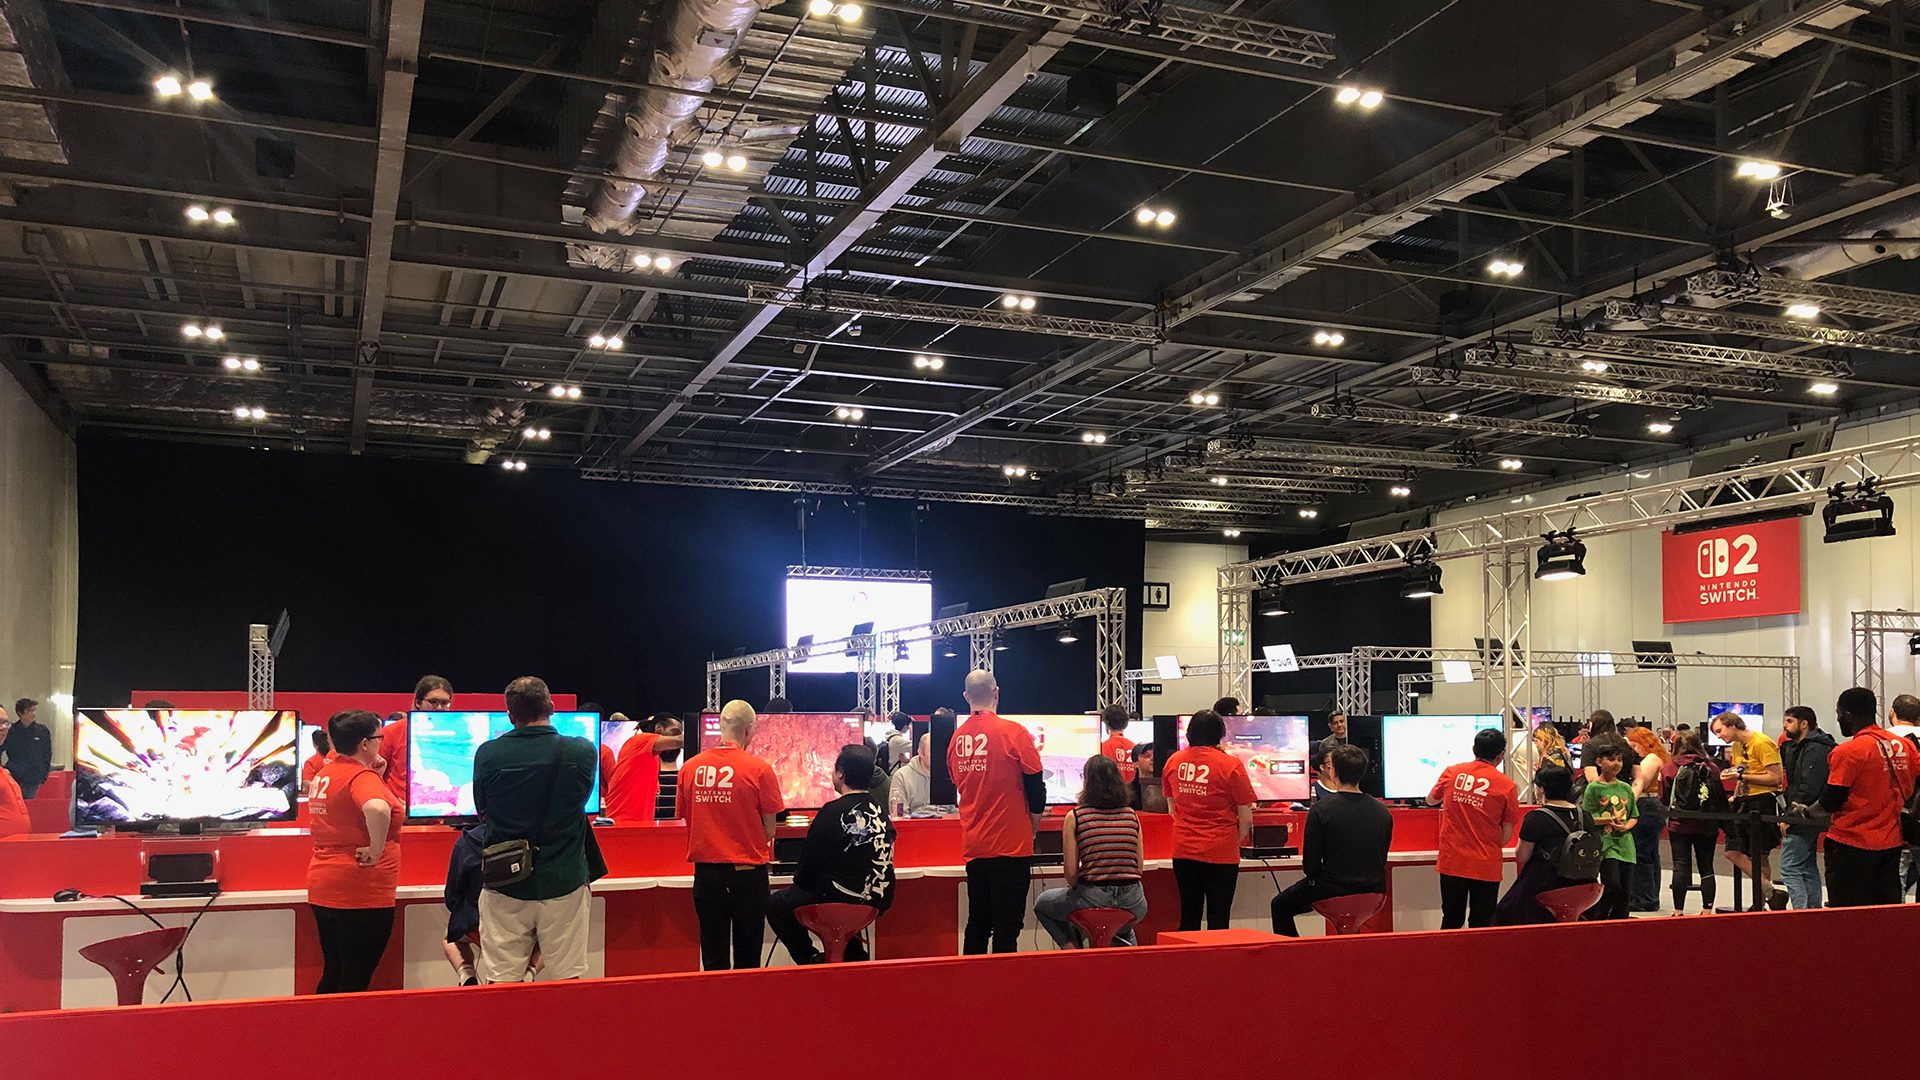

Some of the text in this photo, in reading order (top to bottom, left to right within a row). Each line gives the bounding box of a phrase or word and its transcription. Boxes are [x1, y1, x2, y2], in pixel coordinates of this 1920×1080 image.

[1732, 534, 1758, 575] 2
[1700, 579, 1757, 591] NINTENDO
[1700, 588, 1757, 605] SWITCH
[1271, 657, 1293, 667] TOUR
[973, 733, 988, 756] 2
[1890, 739, 1907, 757] 2
[718, 765, 735, 788] 2
[958, 763, 987, 773] SWITCH
[1195, 764, 1210, 784] 2
[316, 775, 330, 800] 2
[1178, 786, 1207, 797] SWITCH
[1473, 777, 1491, 797] 2
[695, 795, 732, 803] SWITCH
[1453, 795, 1485, 808] SWITCH
